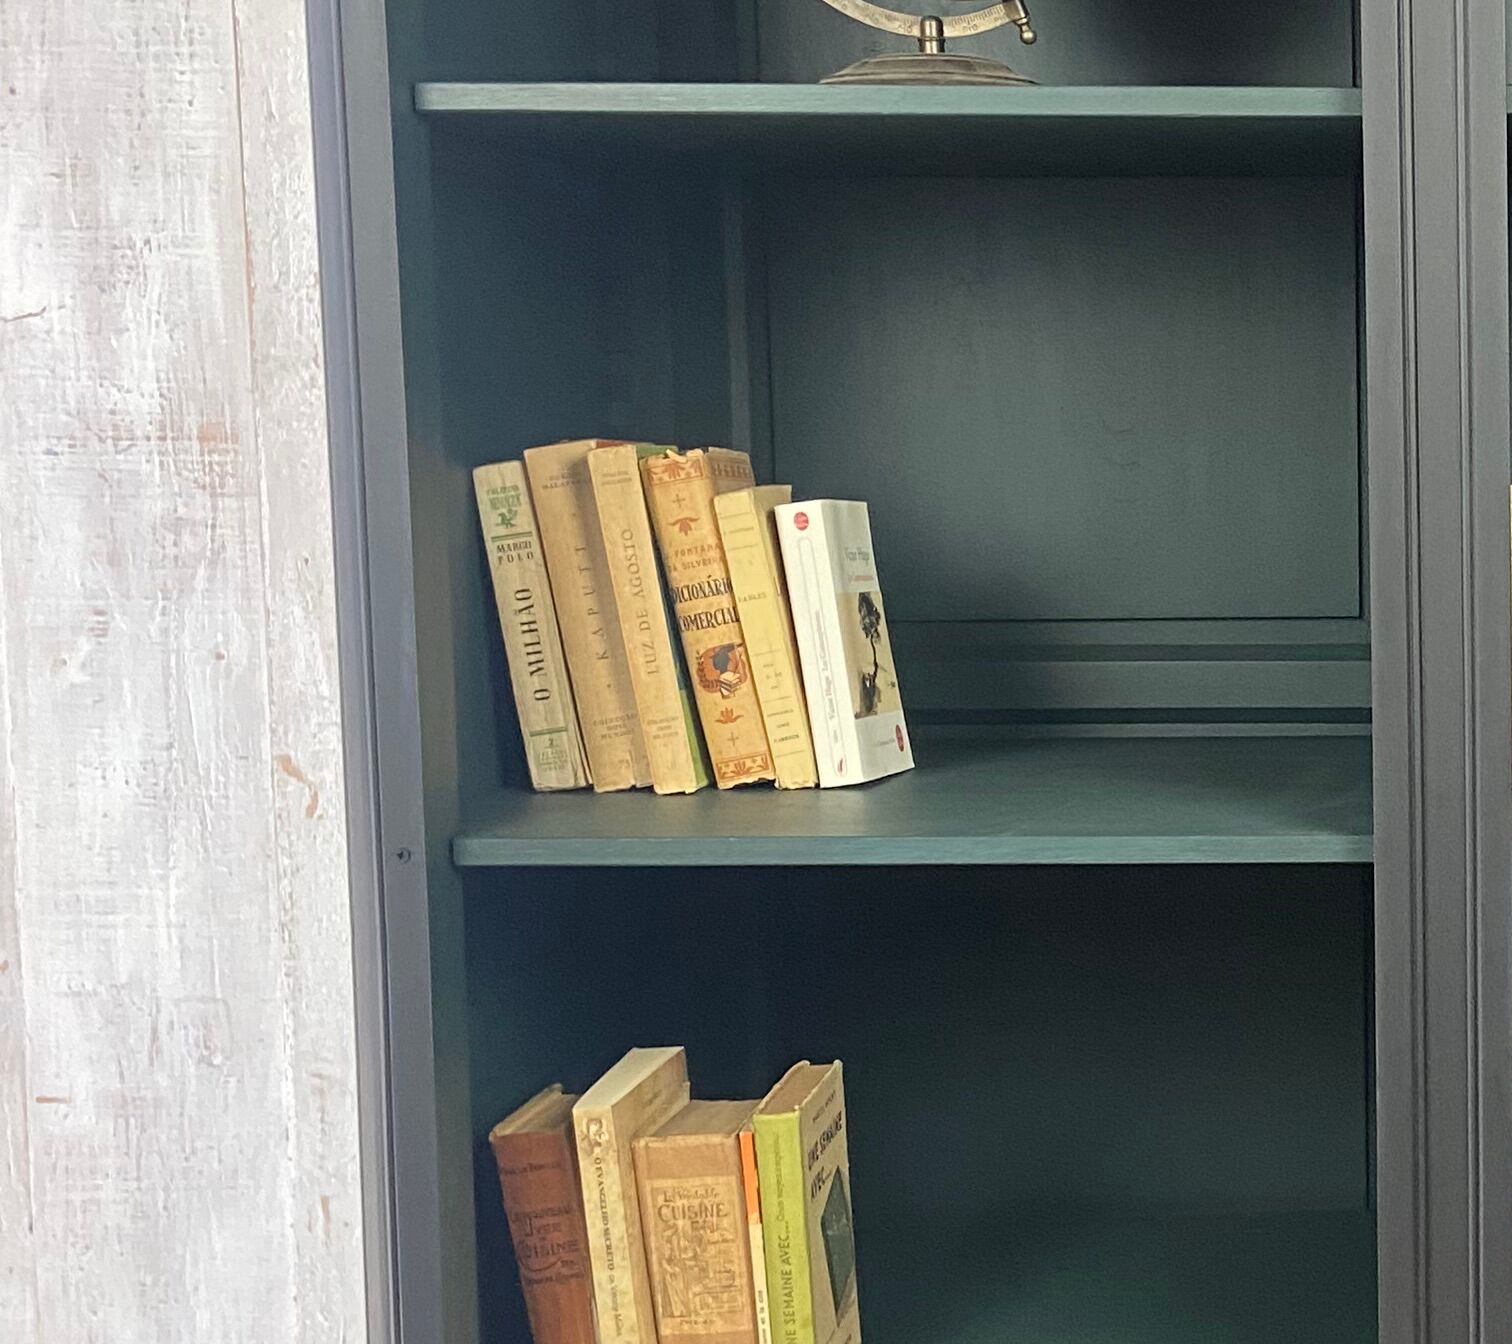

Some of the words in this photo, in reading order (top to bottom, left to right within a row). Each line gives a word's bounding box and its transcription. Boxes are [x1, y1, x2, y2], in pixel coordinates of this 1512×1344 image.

[498, 552, 535, 565] POLO
[622, 529, 645, 598] AGOSTO
[575, 545, 610, 662] KAPUTT
[514, 588, 548, 677] MILHÃO
[637, 613, 652, 633] DE
[643, 641, 660, 676] LUZ
[533, 688, 551, 701] O
[657, 1202, 729, 1223] CUISINE
[781, 1269, 797, 1324] SEMAINE
